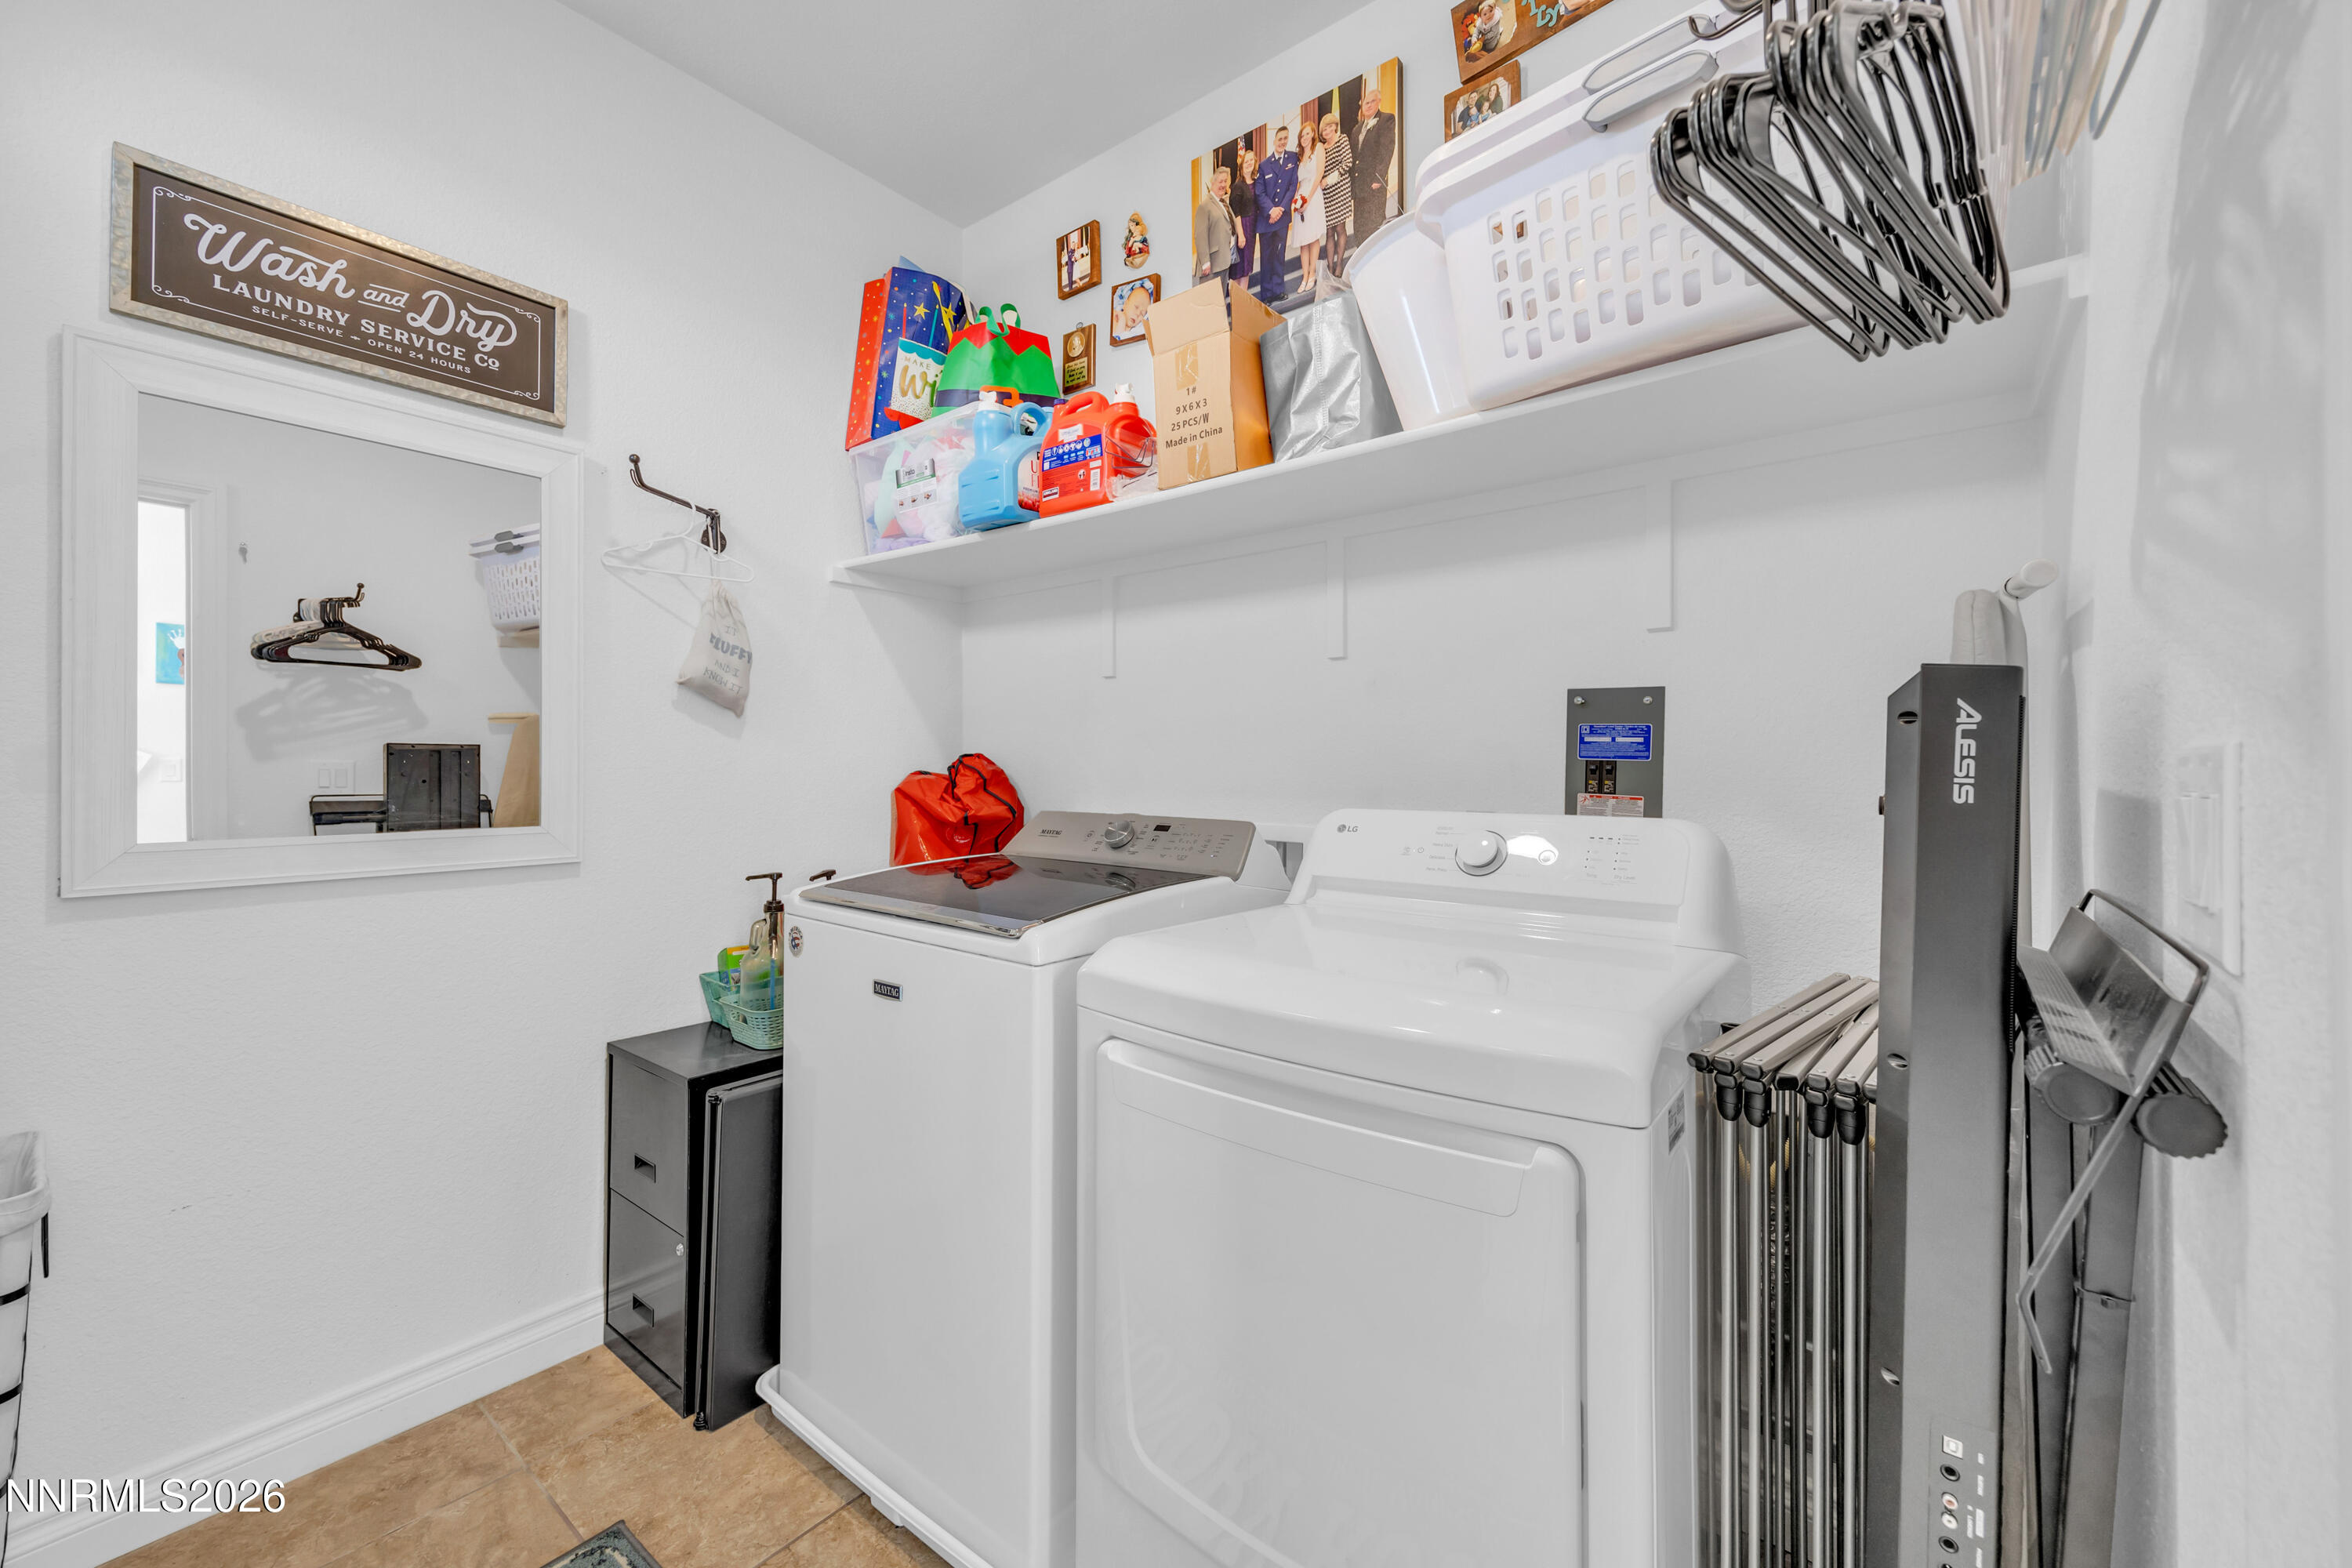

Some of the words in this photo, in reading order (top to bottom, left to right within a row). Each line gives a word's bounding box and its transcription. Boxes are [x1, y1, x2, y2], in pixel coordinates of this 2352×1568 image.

[183, 213, 356, 299] Wash
[363, 284, 410, 308] and
[406, 290, 517, 352] Dry
[212, 274, 350, 326] LAUNDRY
[360, 318, 466, 361] SERVICE
[252, 305, 343, 338] SELF-SERVE
[367, 339, 402, 354] OPEN
[408, 350, 424, 361] 24
[430, 357, 471, 374] HOURS
[904, 356, 931, 370] MAKE
[1166, 436, 1187, 448] Made
[1200, 426, 1223, 439] China
[1171, 422, 1181, 431] 25
[709, 631, 753, 664] FLUFFY
[703, 667, 728, 687] KNOW
[728, 682, 743, 695] IT
[714, 659, 731, 673] AND
[732, 668, 740, 678] I
[1953, 698, 1982, 804] ALESIS
[874, 983, 899, 997] MAYTAG
